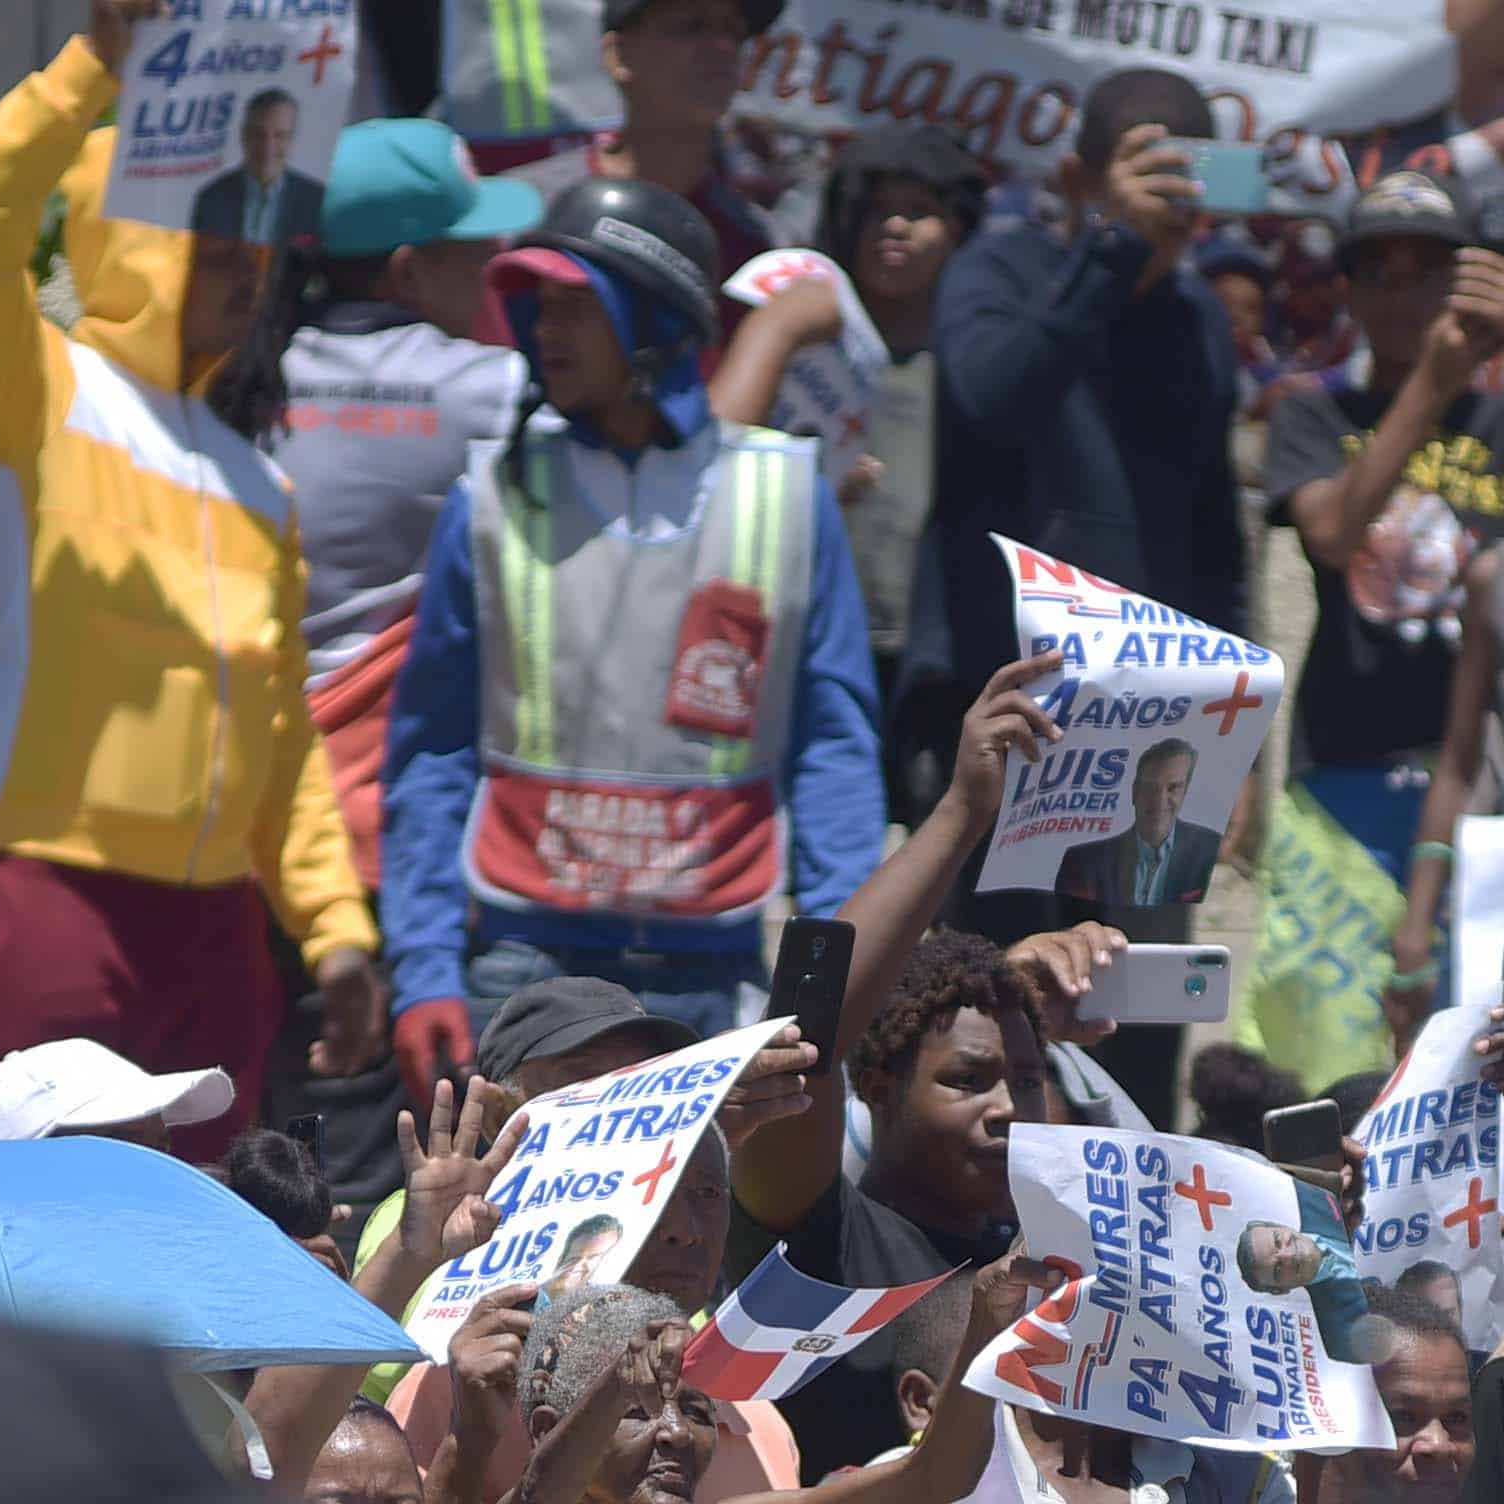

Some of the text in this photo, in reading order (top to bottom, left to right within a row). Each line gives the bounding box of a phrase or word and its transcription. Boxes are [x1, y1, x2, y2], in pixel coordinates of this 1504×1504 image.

[142, 28, 193, 88] 4
[193, 38, 287, 77] AÑOS
[1218, 11, 1318, 74] TAXI
[132, 91, 237, 139] LUIS
[1014, 546, 1140, 595] N
[1114, 632, 1272, 669] ATRAS
[1078, 689, 1193, 731] AÑOS
[1012, 746, 1131, 808] LUIS
[997, 814, 1114, 851] PRESIDENTE
[1004, 791, 1121, 829] ABINADER
[596, 1055, 740, 1108] MIRES
[1364, 1078, 1498, 1148] MIRES
[567, 1092, 716, 1150] ATRAS
[1363, 1124, 1498, 1194] ATRAS
[489, 1164, 534, 1232] 4
[521, 1168, 625, 1214] AÑOS
[1083, 1137, 1129, 1314] MIRES
[442, 1220, 560, 1283] LUIS
[1134, 1142, 1179, 1336] ATRAS
[1196, 1243, 1233, 1369] AÑOS
[1179, 1369, 1244, 1436] 4
[1245, 1303, 1294, 1441] LUIS
[1277, 1309, 1316, 1437] ABINADER
[1296, 1312, 1344, 1436] PRESIDENTE
